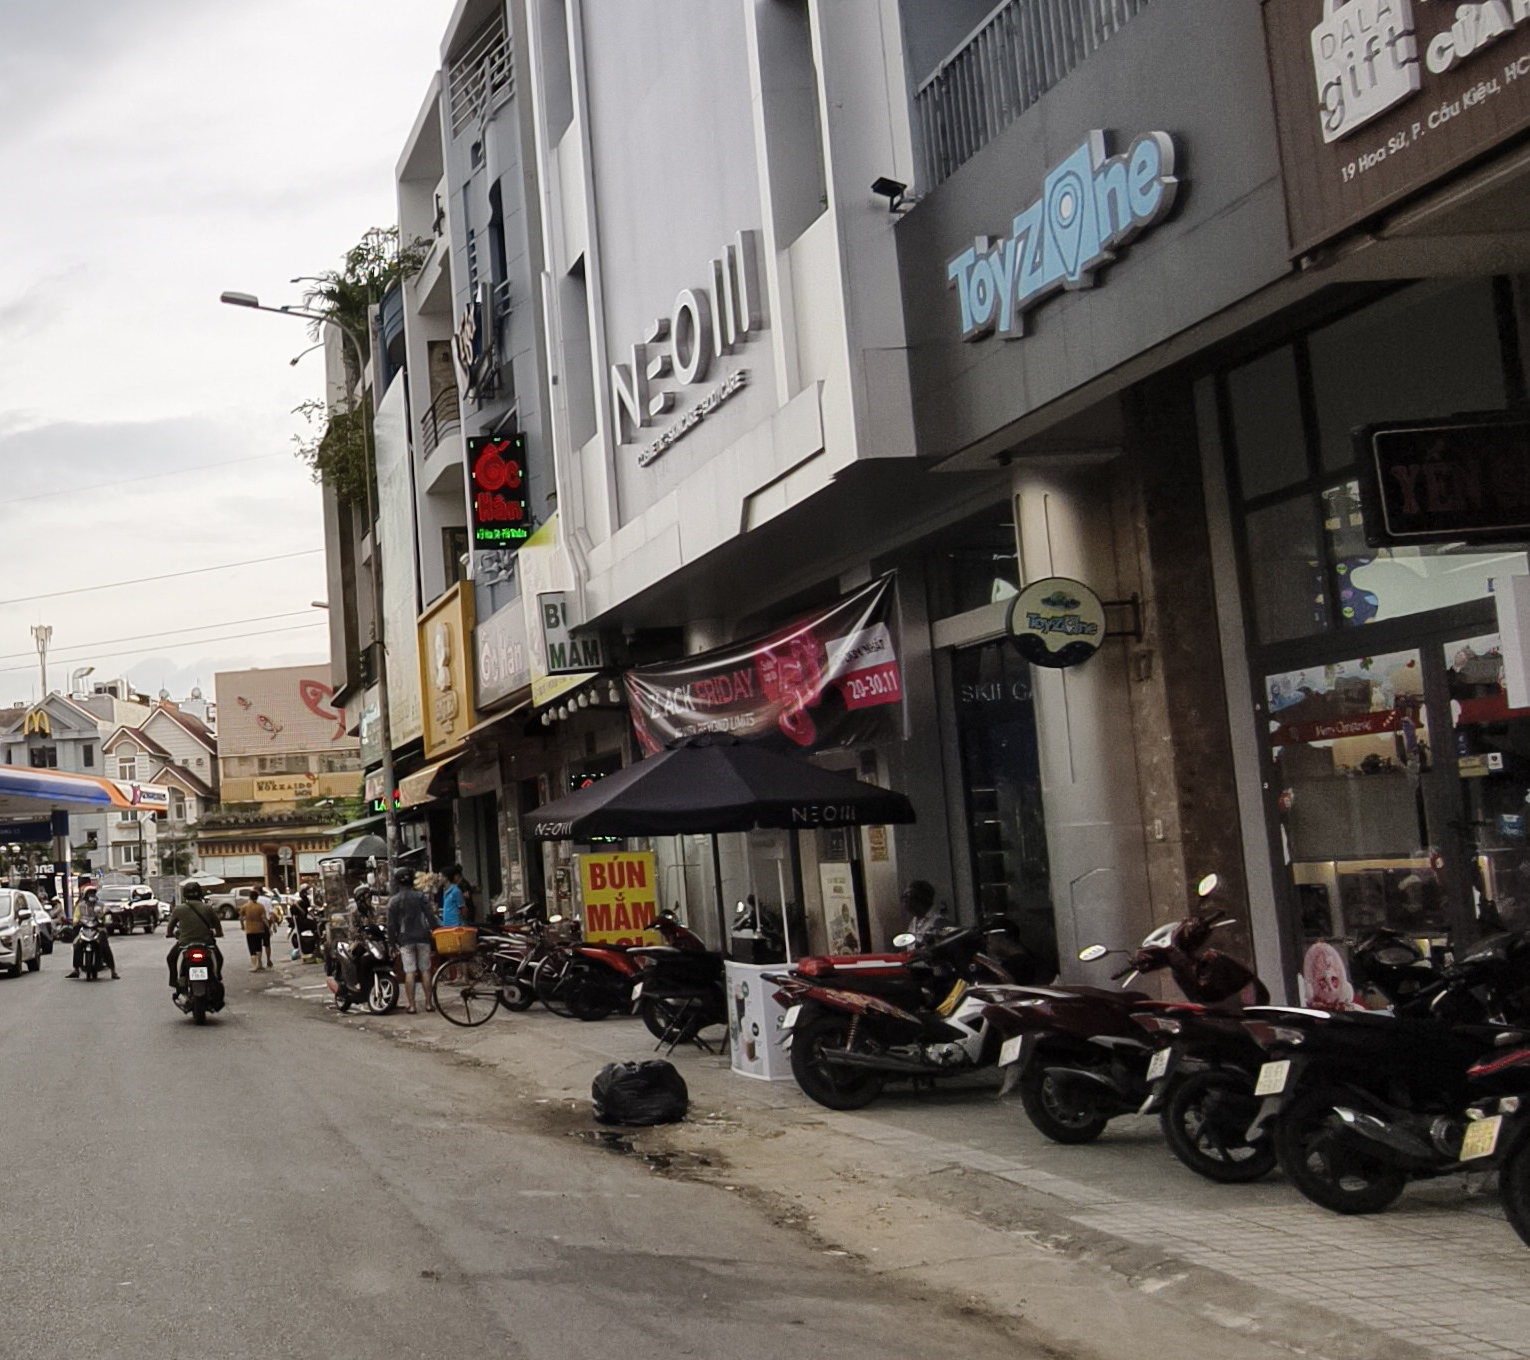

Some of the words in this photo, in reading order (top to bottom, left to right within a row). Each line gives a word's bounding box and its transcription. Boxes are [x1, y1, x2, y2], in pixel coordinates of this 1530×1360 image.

[1426, 0, 1516, 74] CỬA
[1321, 26, 1419, 133] gift
[1341, 162, 1356, 183] 19
[1358, 147, 1386, 174] Hoa
[1411, 122, 1425, 140] P.
[650, 684, 695, 720] ACK
[693, 667, 753, 708] FRIDAY
[847, 670, 898, 700] 20-30.11
[589, 855, 647, 891] BÚN
[586, 891, 657, 933] MẮM
